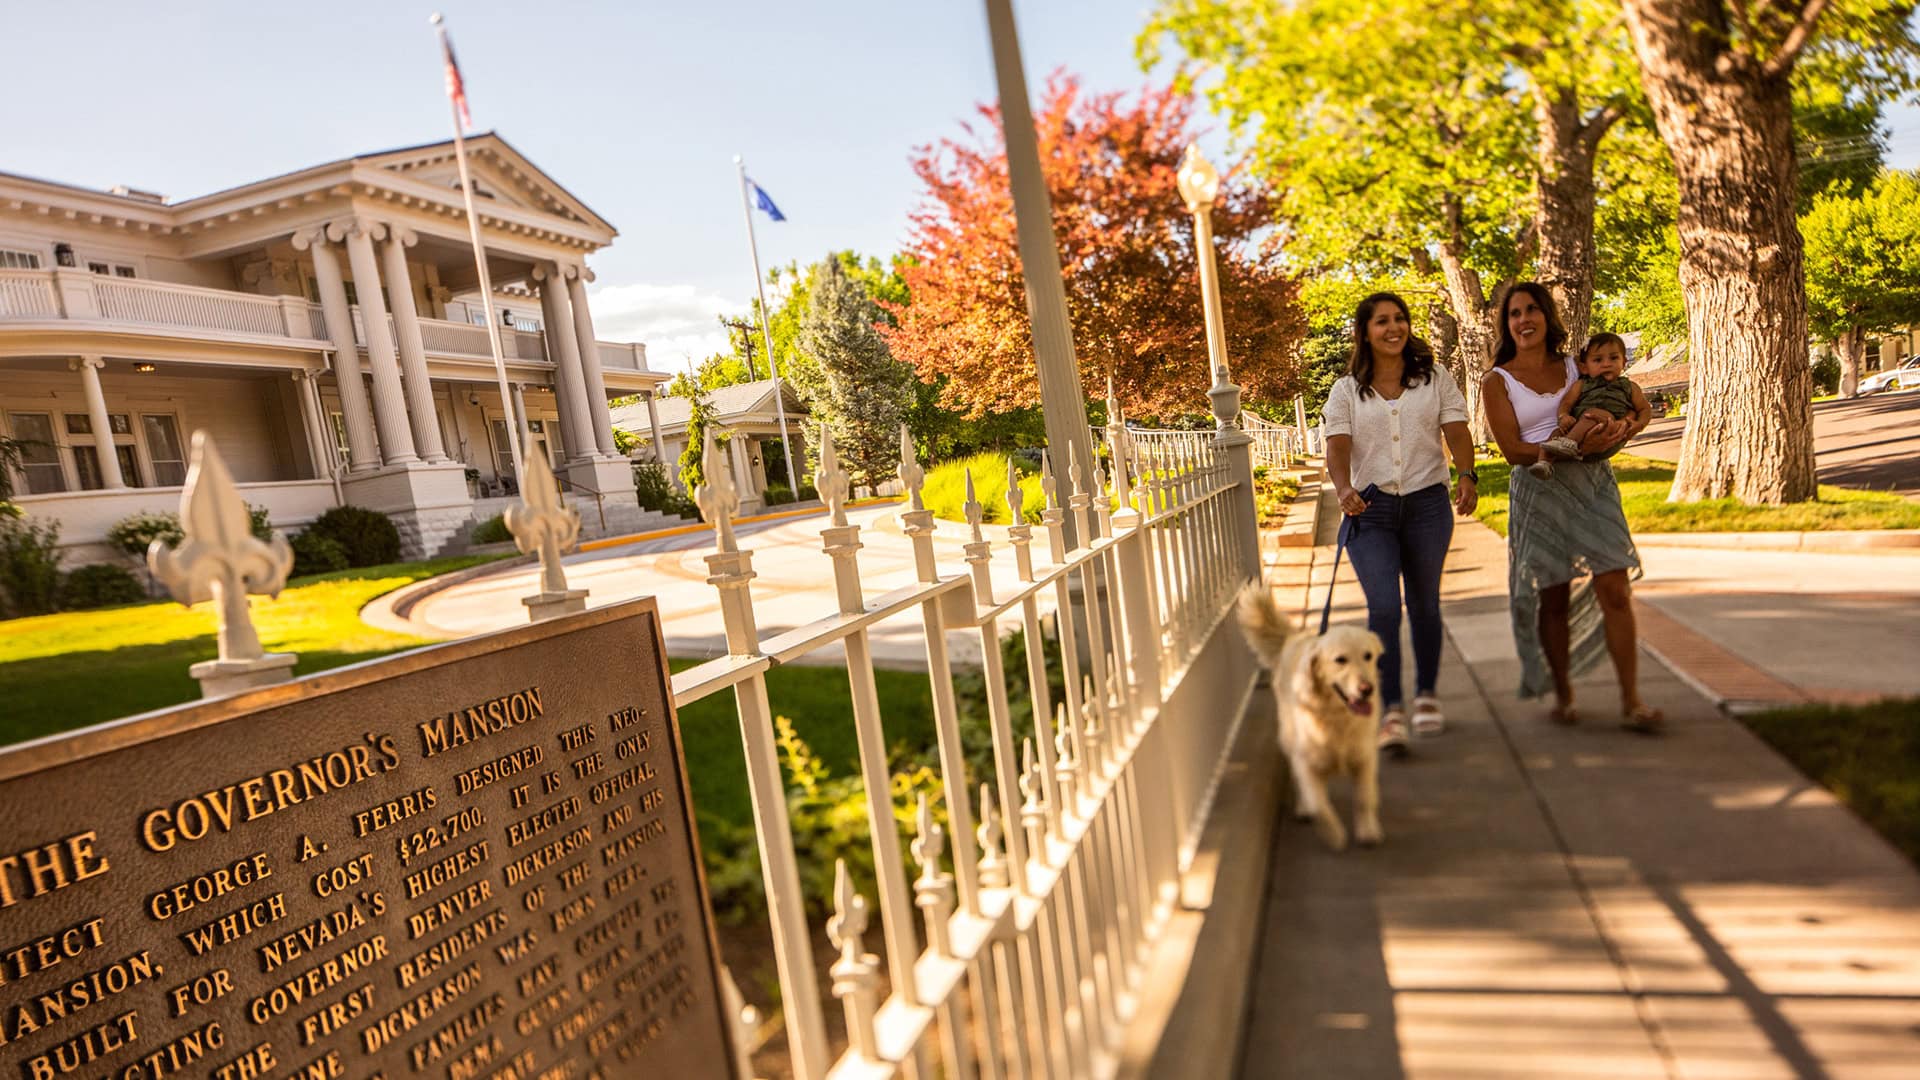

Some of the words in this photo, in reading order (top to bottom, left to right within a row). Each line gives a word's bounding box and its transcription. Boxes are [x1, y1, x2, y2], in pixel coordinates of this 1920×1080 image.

[0, 830, 110, 908] THE
[143, 733, 400, 852] GOVERNOR'S
[420, 687, 544, 757] MANSION
[151, 853, 272, 921] GEORGE
[301, 835, 329, 862] A.
[356, 787, 437, 838] FERRIS
[458, 745, 544, 795] DESIGNED
[561, 724, 597, 751] THIS
[612, 706, 648, 732] NEO-
[186, 892, 287, 955] WHICH
[316, 853, 374, 898] COST
[401, 806, 487, 867] $22,700.
[513, 784, 531, 809] IT
[545, 771, 562, 794] IS
[575, 752, 605, 779] THE
[618, 730, 651, 760] ONLY
[29, 1010, 138, 1080] BUILT
[172, 968, 234, 1016] FOR
[262, 892, 387, 972] NEVADA'S
[407, 840, 490, 899] HIGHEST
[509, 796, 583, 847] ELECTED
[592, 762, 658, 805] OFFICIAL.
[107, 1022, 225, 1080] CTING
[252, 935, 390, 1025] GOVERNOR
[410, 880, 493, 939] DENVER
[505, 825, 593, 887] DICKERSON
[605, 804, 632, 833] AND
[642, 788, 665, 813] HIS
[216, 1042, 278, 1080] THE
[303, 983, 376, 1047] FIRST
[400, 908, 509, 988] RESIDENTS
[525, 884, 545, 912] OF
[561, 861, 592, 892] THE
[364, 961, 481, 1054] DICKERSON
[498, 926, 539, 966] WAS
